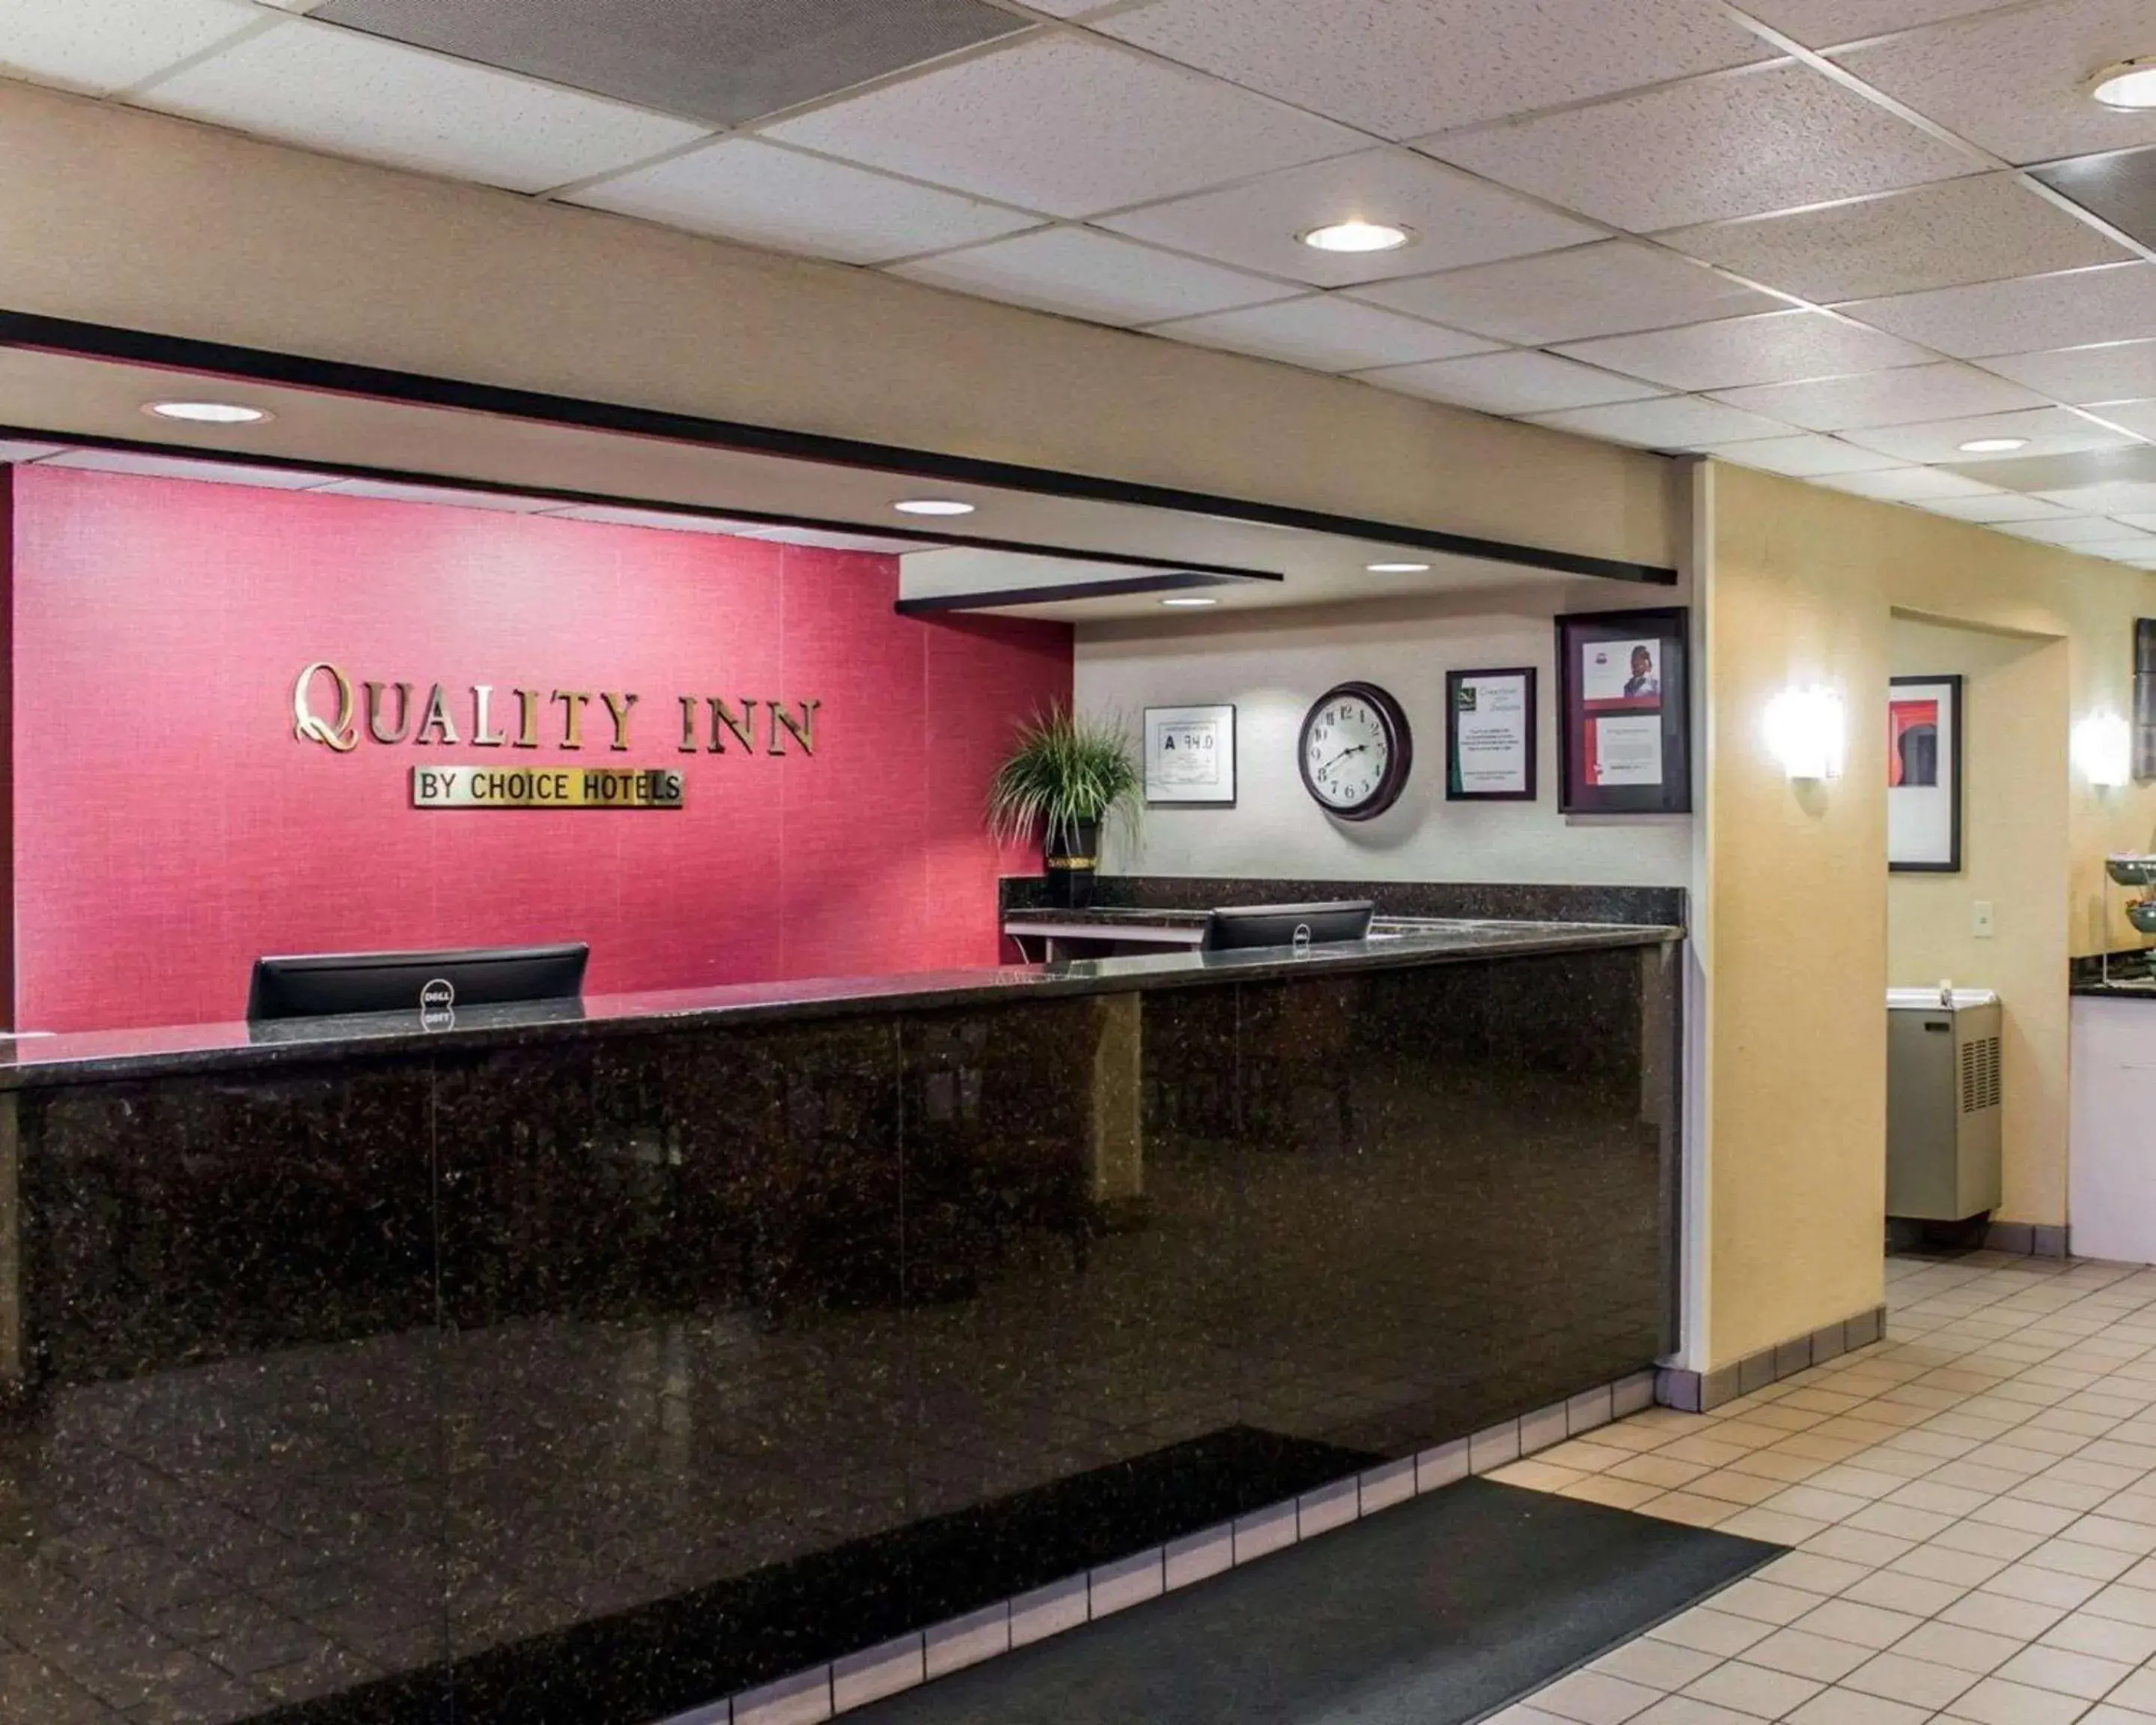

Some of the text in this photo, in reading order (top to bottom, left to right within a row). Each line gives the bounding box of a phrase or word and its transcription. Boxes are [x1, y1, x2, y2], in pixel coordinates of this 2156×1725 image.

[294, 662, 821, 756] QUALITY INN
[1340, 705, 1352, 720] 12
[1370, 722, 1379, 736] 2
[1164, 734, 1175, 749] A
[1318, 767, 1327, 782] 8
[421, 773, 680, 800] BY CHOICE HOTELS
[1330, 780, 1339, 794] 7
[1345, 785, 1355, 799] 6
